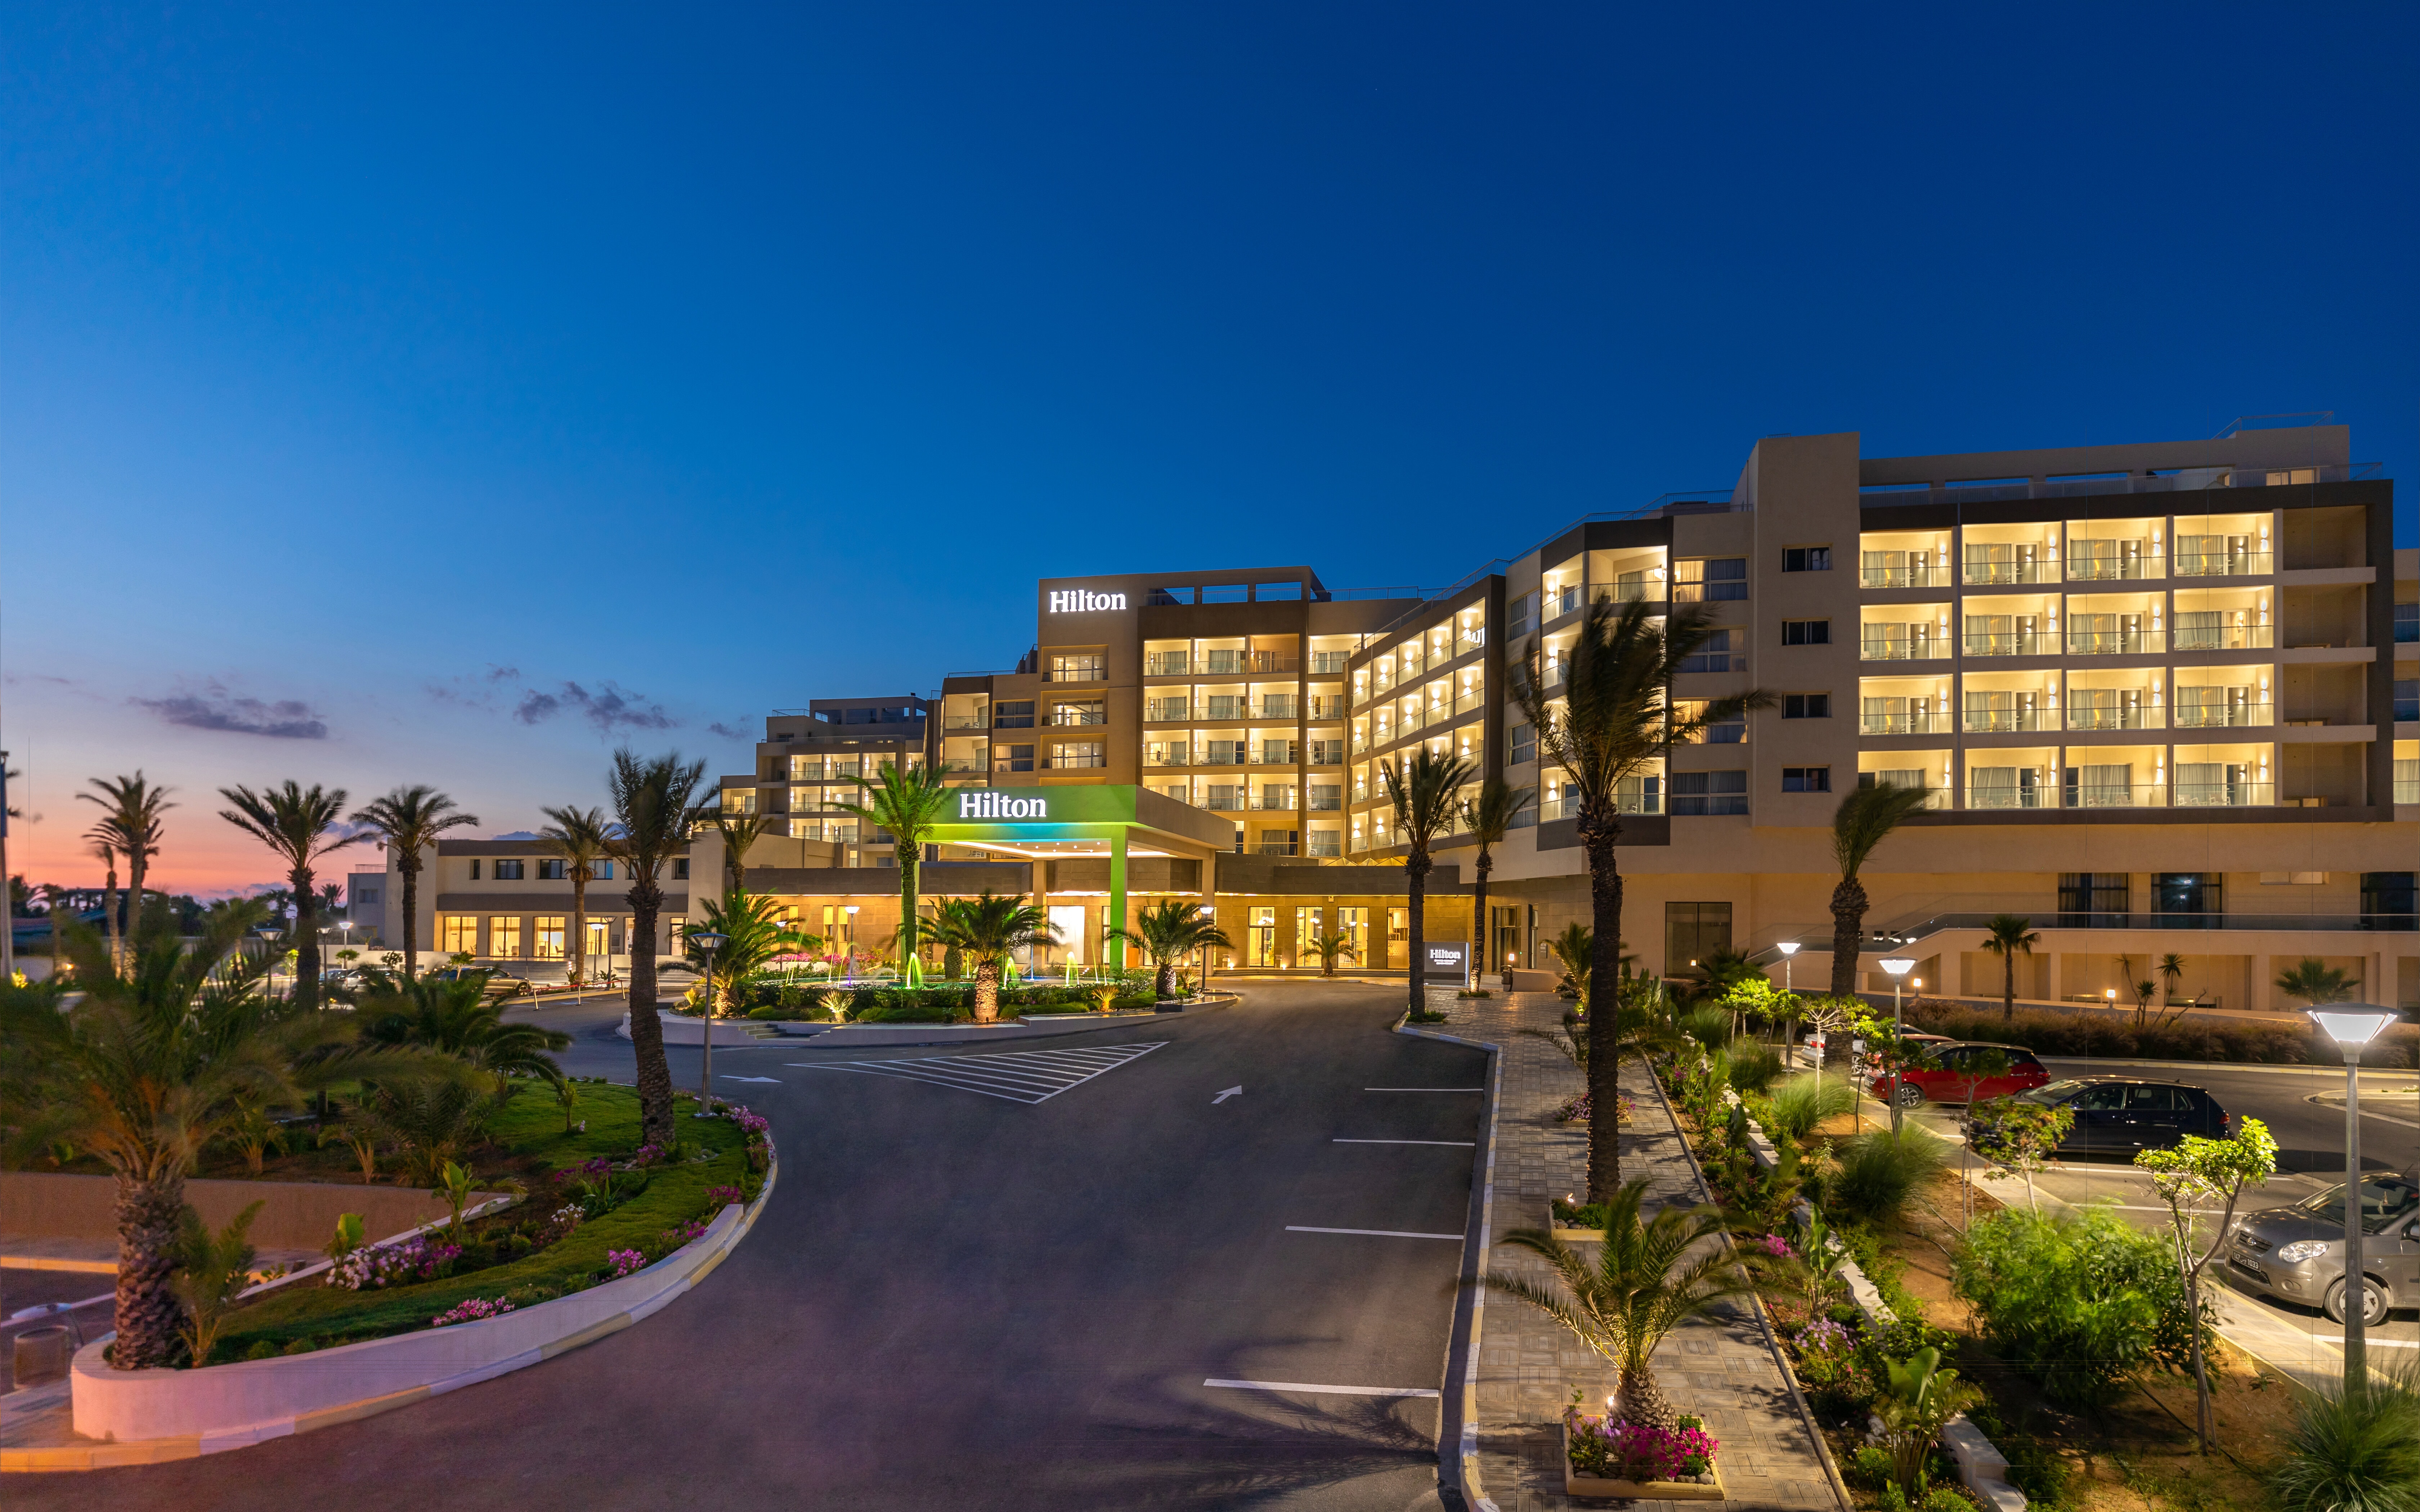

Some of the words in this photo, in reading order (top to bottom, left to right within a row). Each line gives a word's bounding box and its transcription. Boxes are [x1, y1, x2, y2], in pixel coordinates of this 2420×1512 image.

[1050, 589, 1126, 612] Hilton
[960, 792, 1047, 818] Hilton
[1430, 949, 1461, 959] Hilton
[2248, 1259, 2258, 1269] 1033
